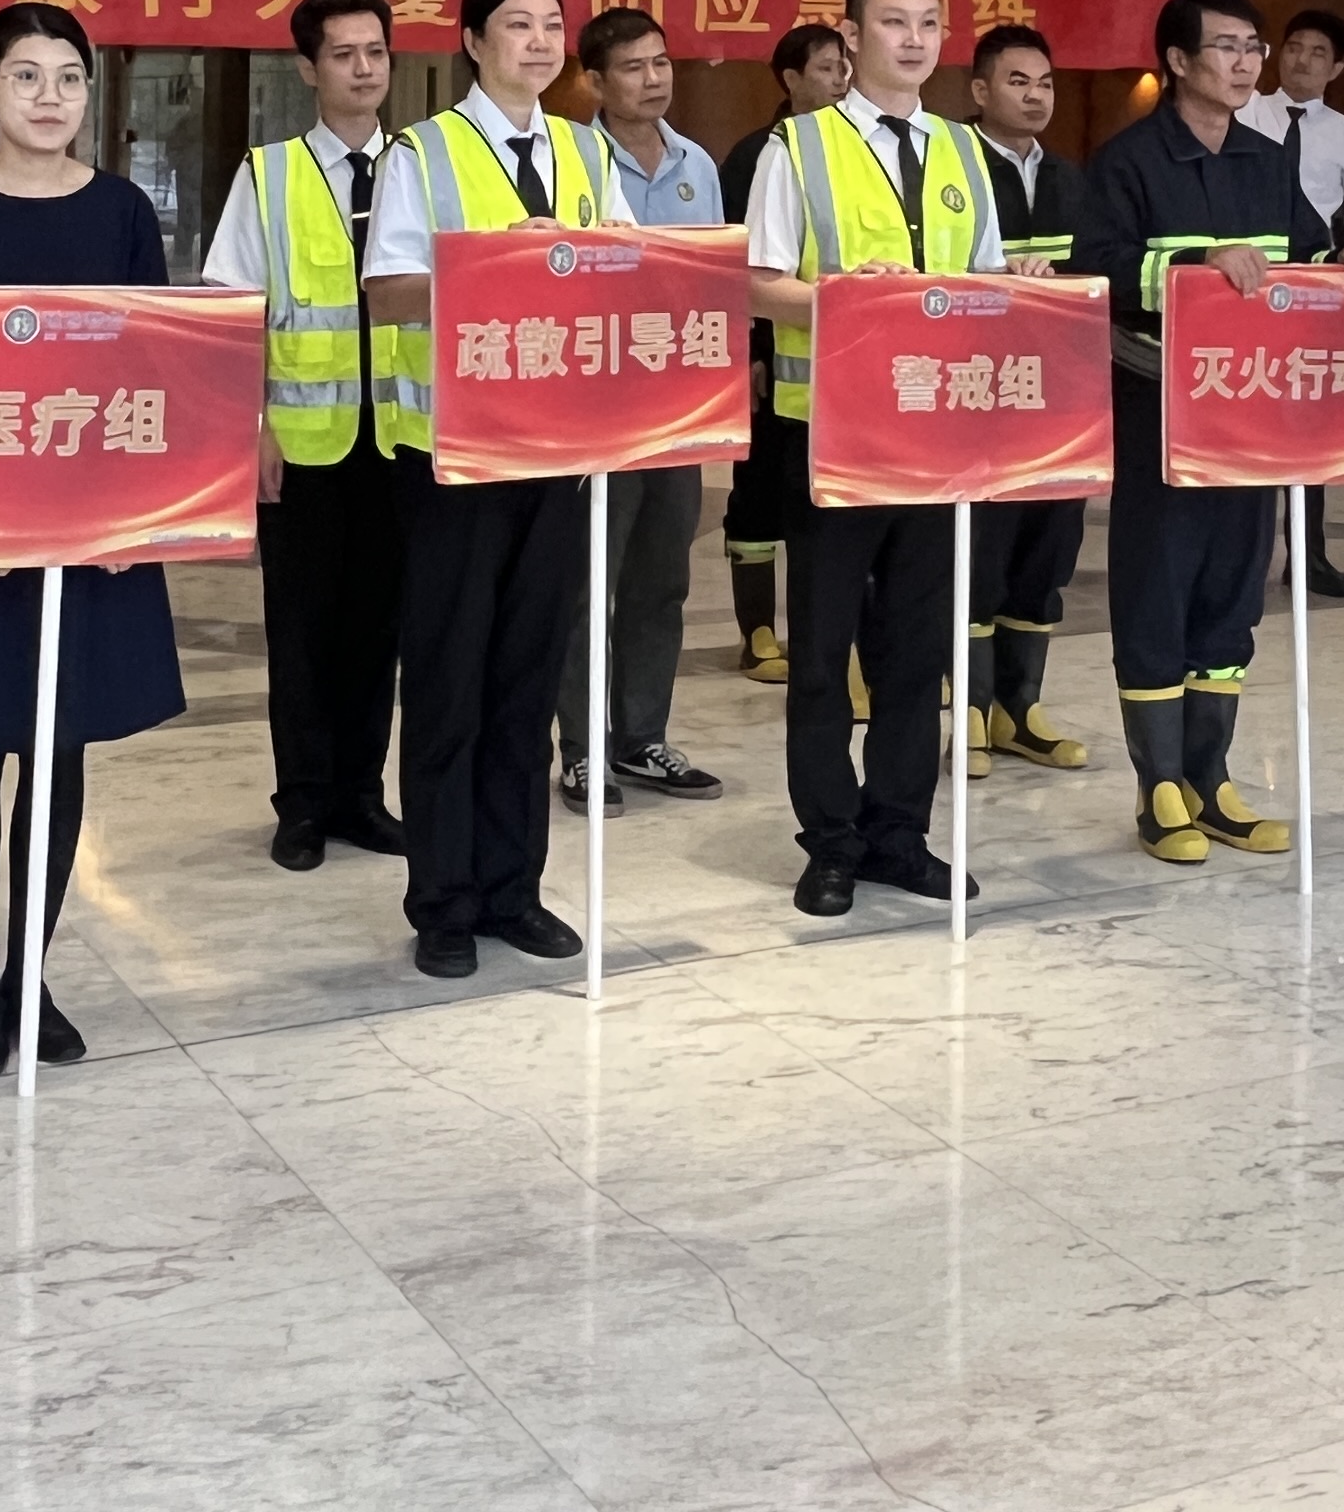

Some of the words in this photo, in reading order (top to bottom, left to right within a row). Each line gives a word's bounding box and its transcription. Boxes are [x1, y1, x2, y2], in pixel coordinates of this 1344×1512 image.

[455, 309, 733, 381] 疏散引导组
[890, 353, 1046, 413] 警戒组
